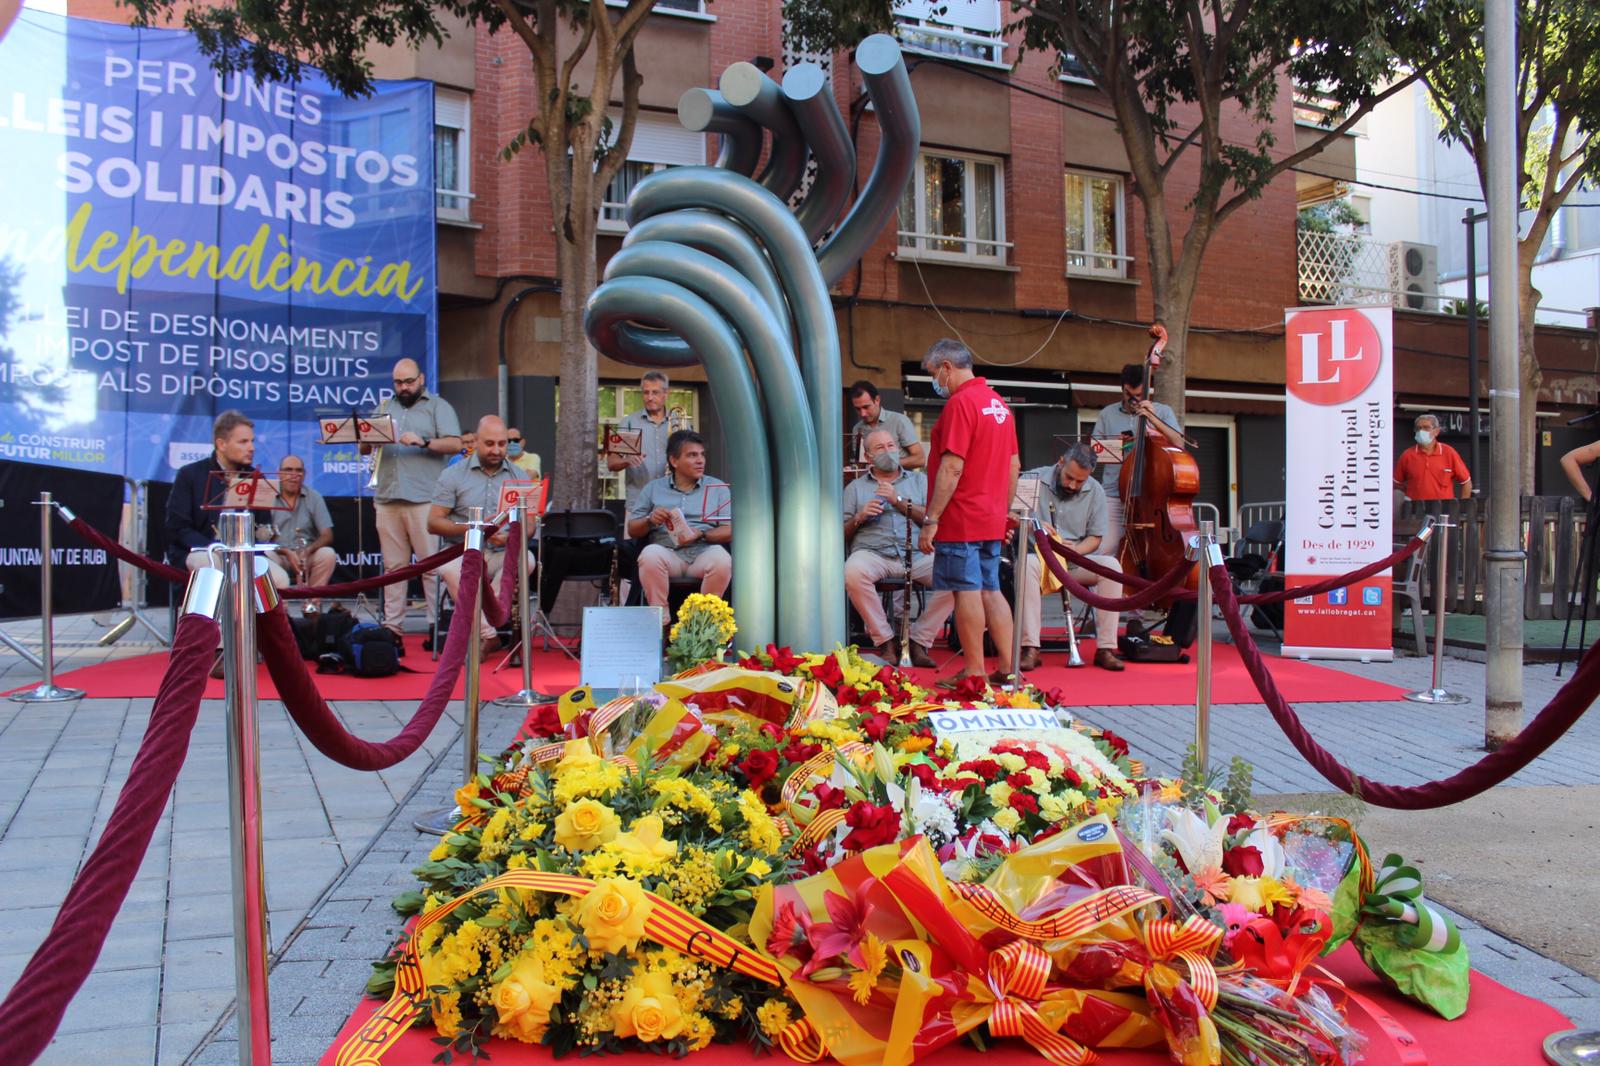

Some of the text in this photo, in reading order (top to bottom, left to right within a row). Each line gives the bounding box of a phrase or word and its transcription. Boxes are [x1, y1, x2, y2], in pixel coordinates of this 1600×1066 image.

[104, 55, 322, 126] PER UNES
[0, 92, 419, 187] LEIS I IMPOSTOS
[56, 151, 356, 229] SOLIDARIS
[101, 309, 139, 332] DE
[150, 312, 380, 351] DESNONAMENTS
[160, 343, 199, 366] DE
[209, 346, 286, 373] PISOS
[294, 355, 369, 378] BUITS
[98, 371, 151, 393] ALS
[162, 372, 281, 402] DIPÒSITS
[19, 433, 106, 449] CONSTRUIR
[52, 450, 105, 463] MILLOR
[1341, 409, 1363, 528] La Principal
[1363, 402, 1385, 530] del Llobregat
[1318, 474, 1335, 529] Cobla
[66, 548, 81, 565] DE
[1302, 540, 1375, 550] Des de 1929
[936, 713, 1060, 731] ÒMNIUM
